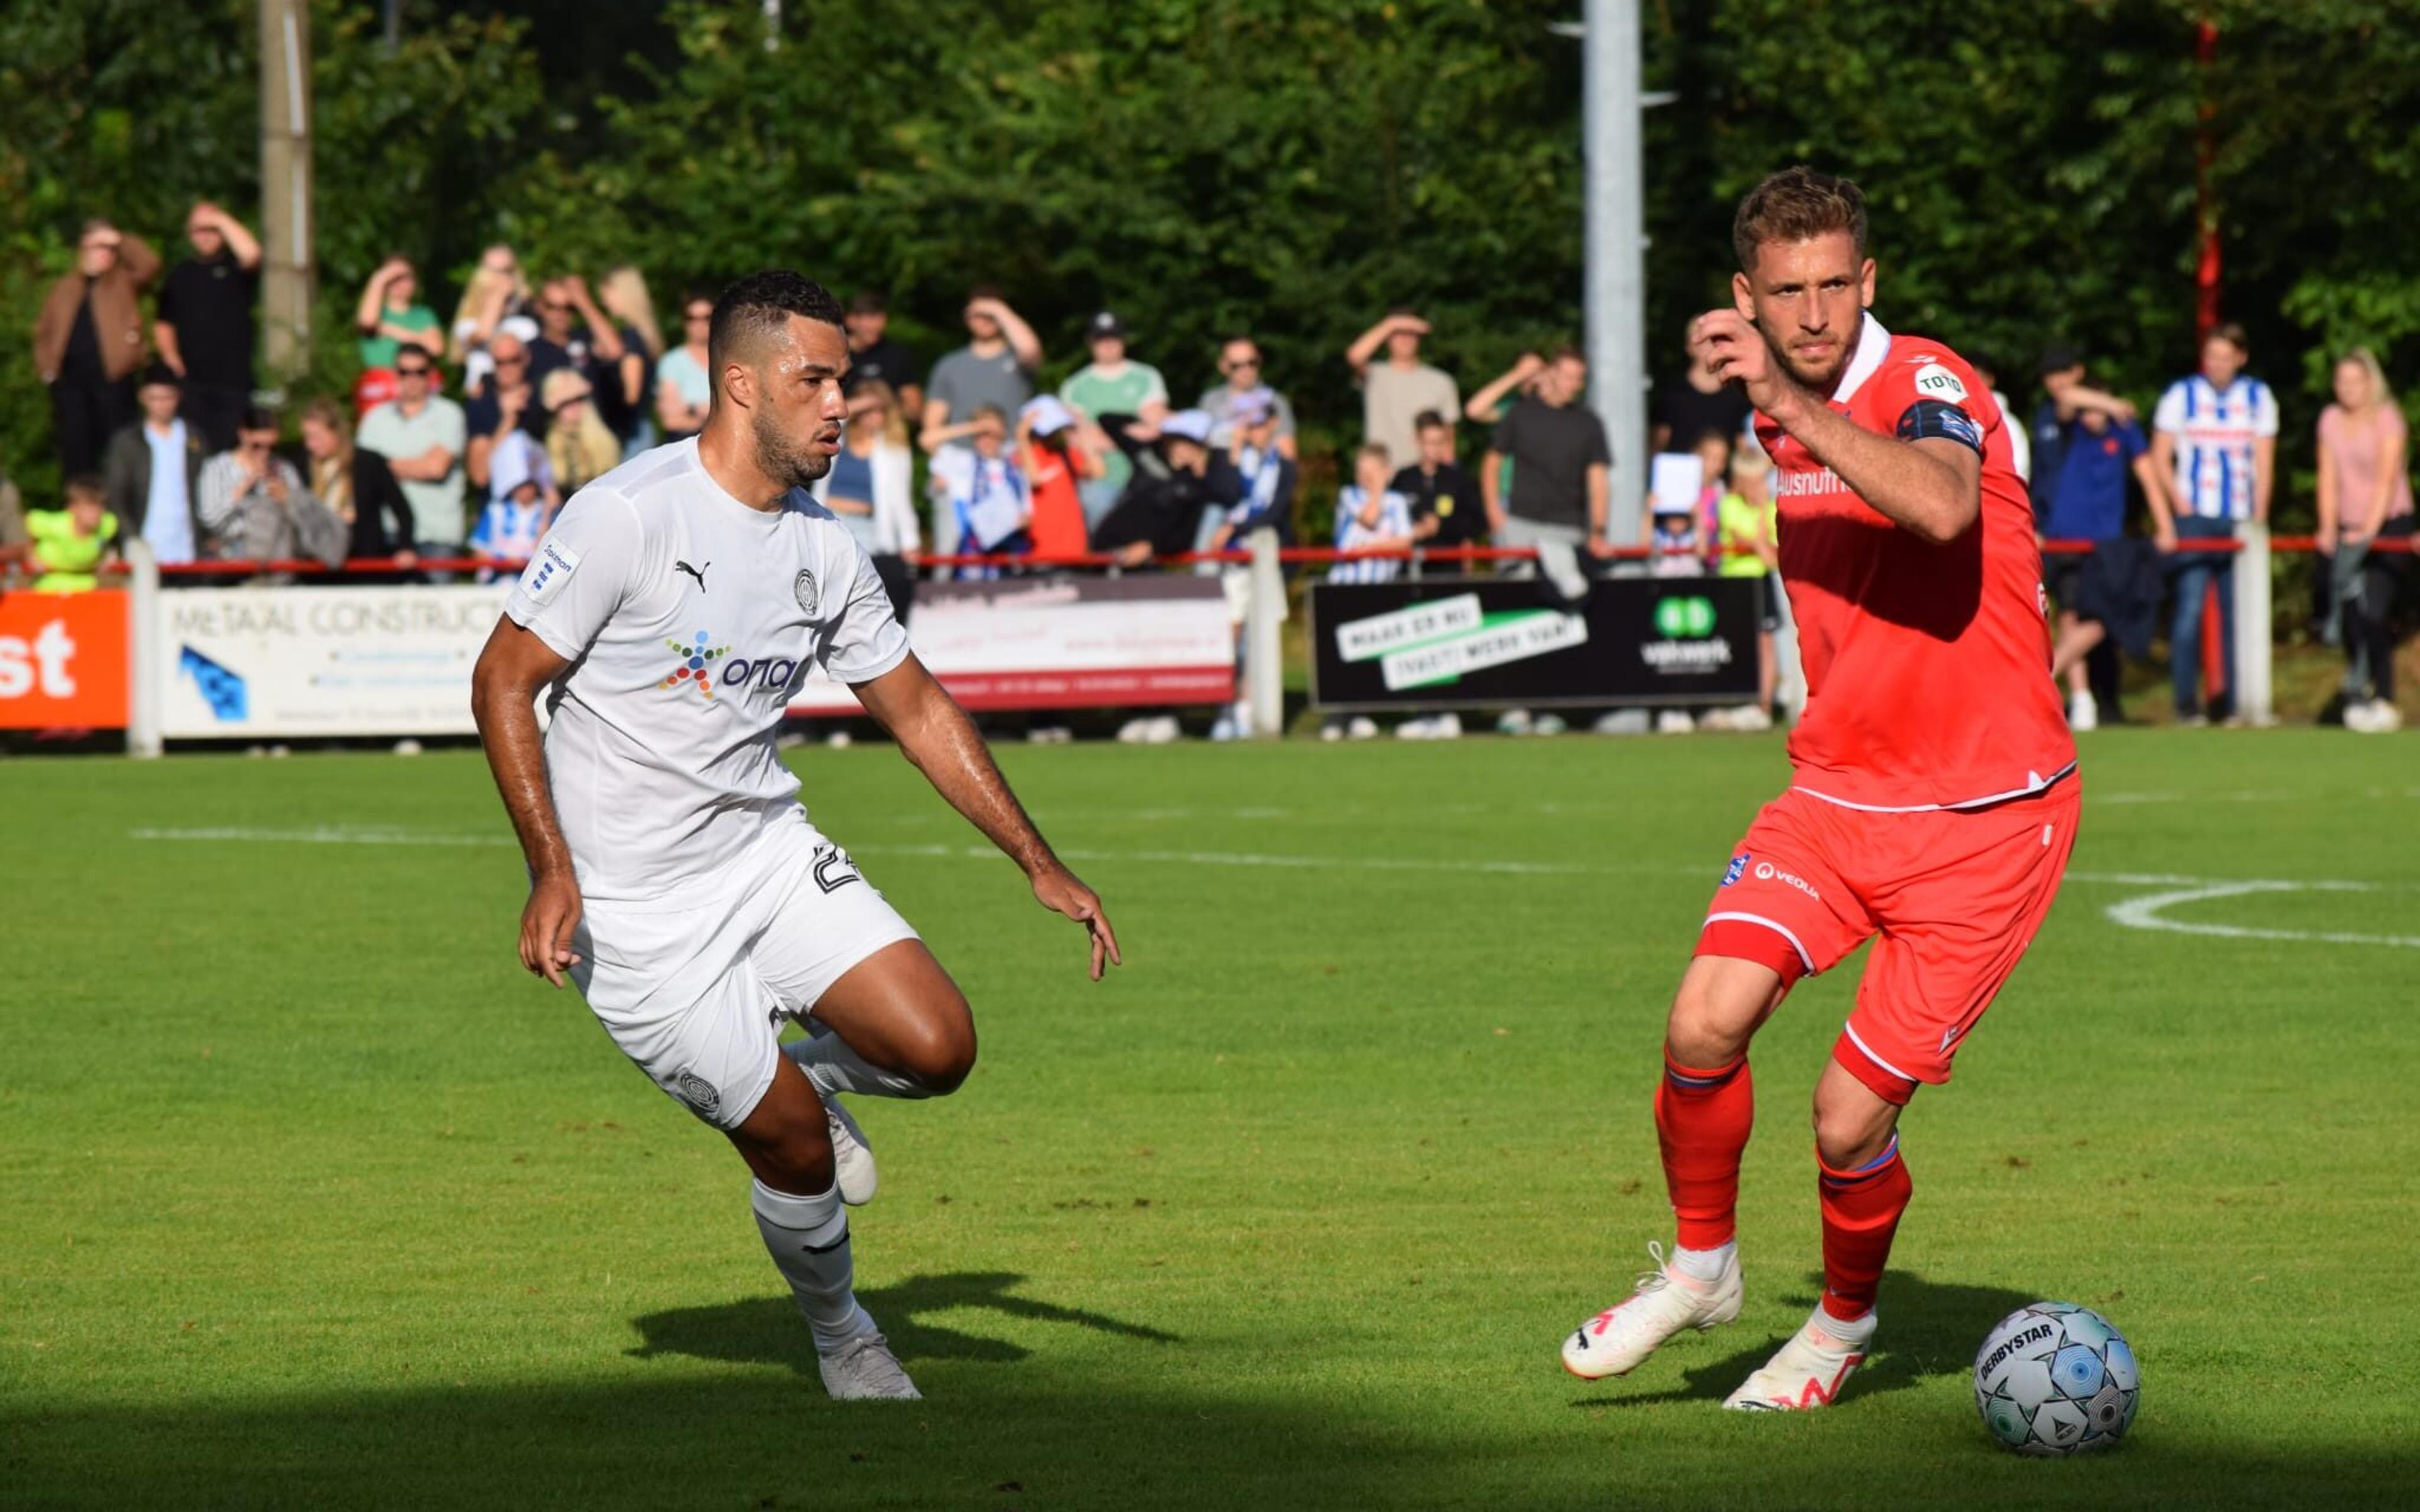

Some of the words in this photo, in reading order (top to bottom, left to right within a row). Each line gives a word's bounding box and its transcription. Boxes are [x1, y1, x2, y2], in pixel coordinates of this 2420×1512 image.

[1920, 375, 1962, 393] TOTO
[308, 598, 504, 634] CONSTRUCT
[1981, 1324, 2053, 1380] DERBYSTAR
